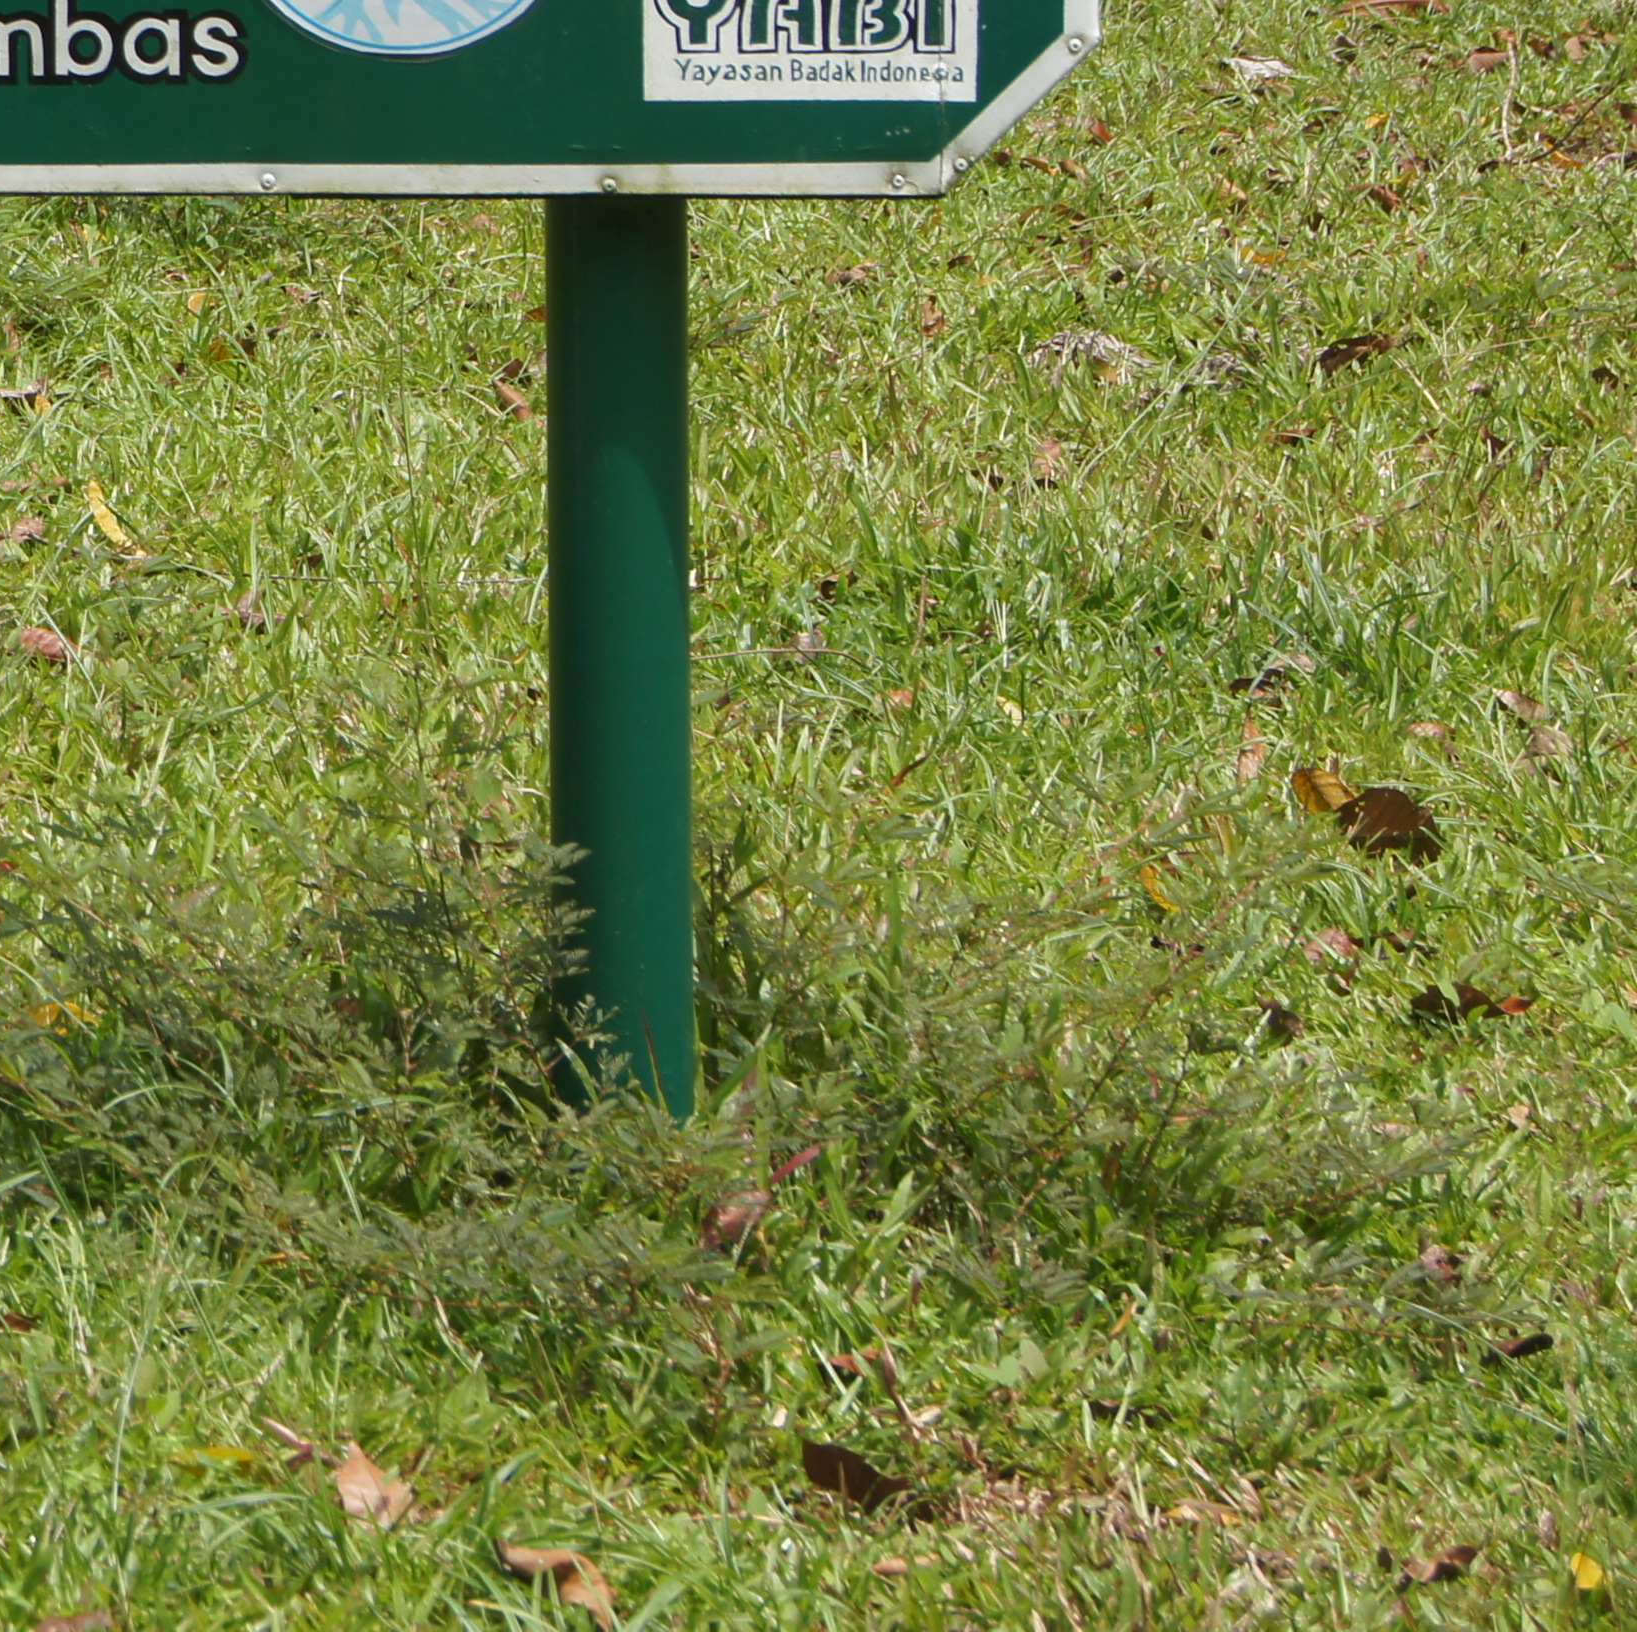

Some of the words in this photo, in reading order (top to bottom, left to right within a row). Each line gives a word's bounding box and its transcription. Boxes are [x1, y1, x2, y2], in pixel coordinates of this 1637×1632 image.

[674, 57, 782, 85] Yayasan
[790, 57, 856, 83] Badak
[860, 58, 965, 84] Indonesia
